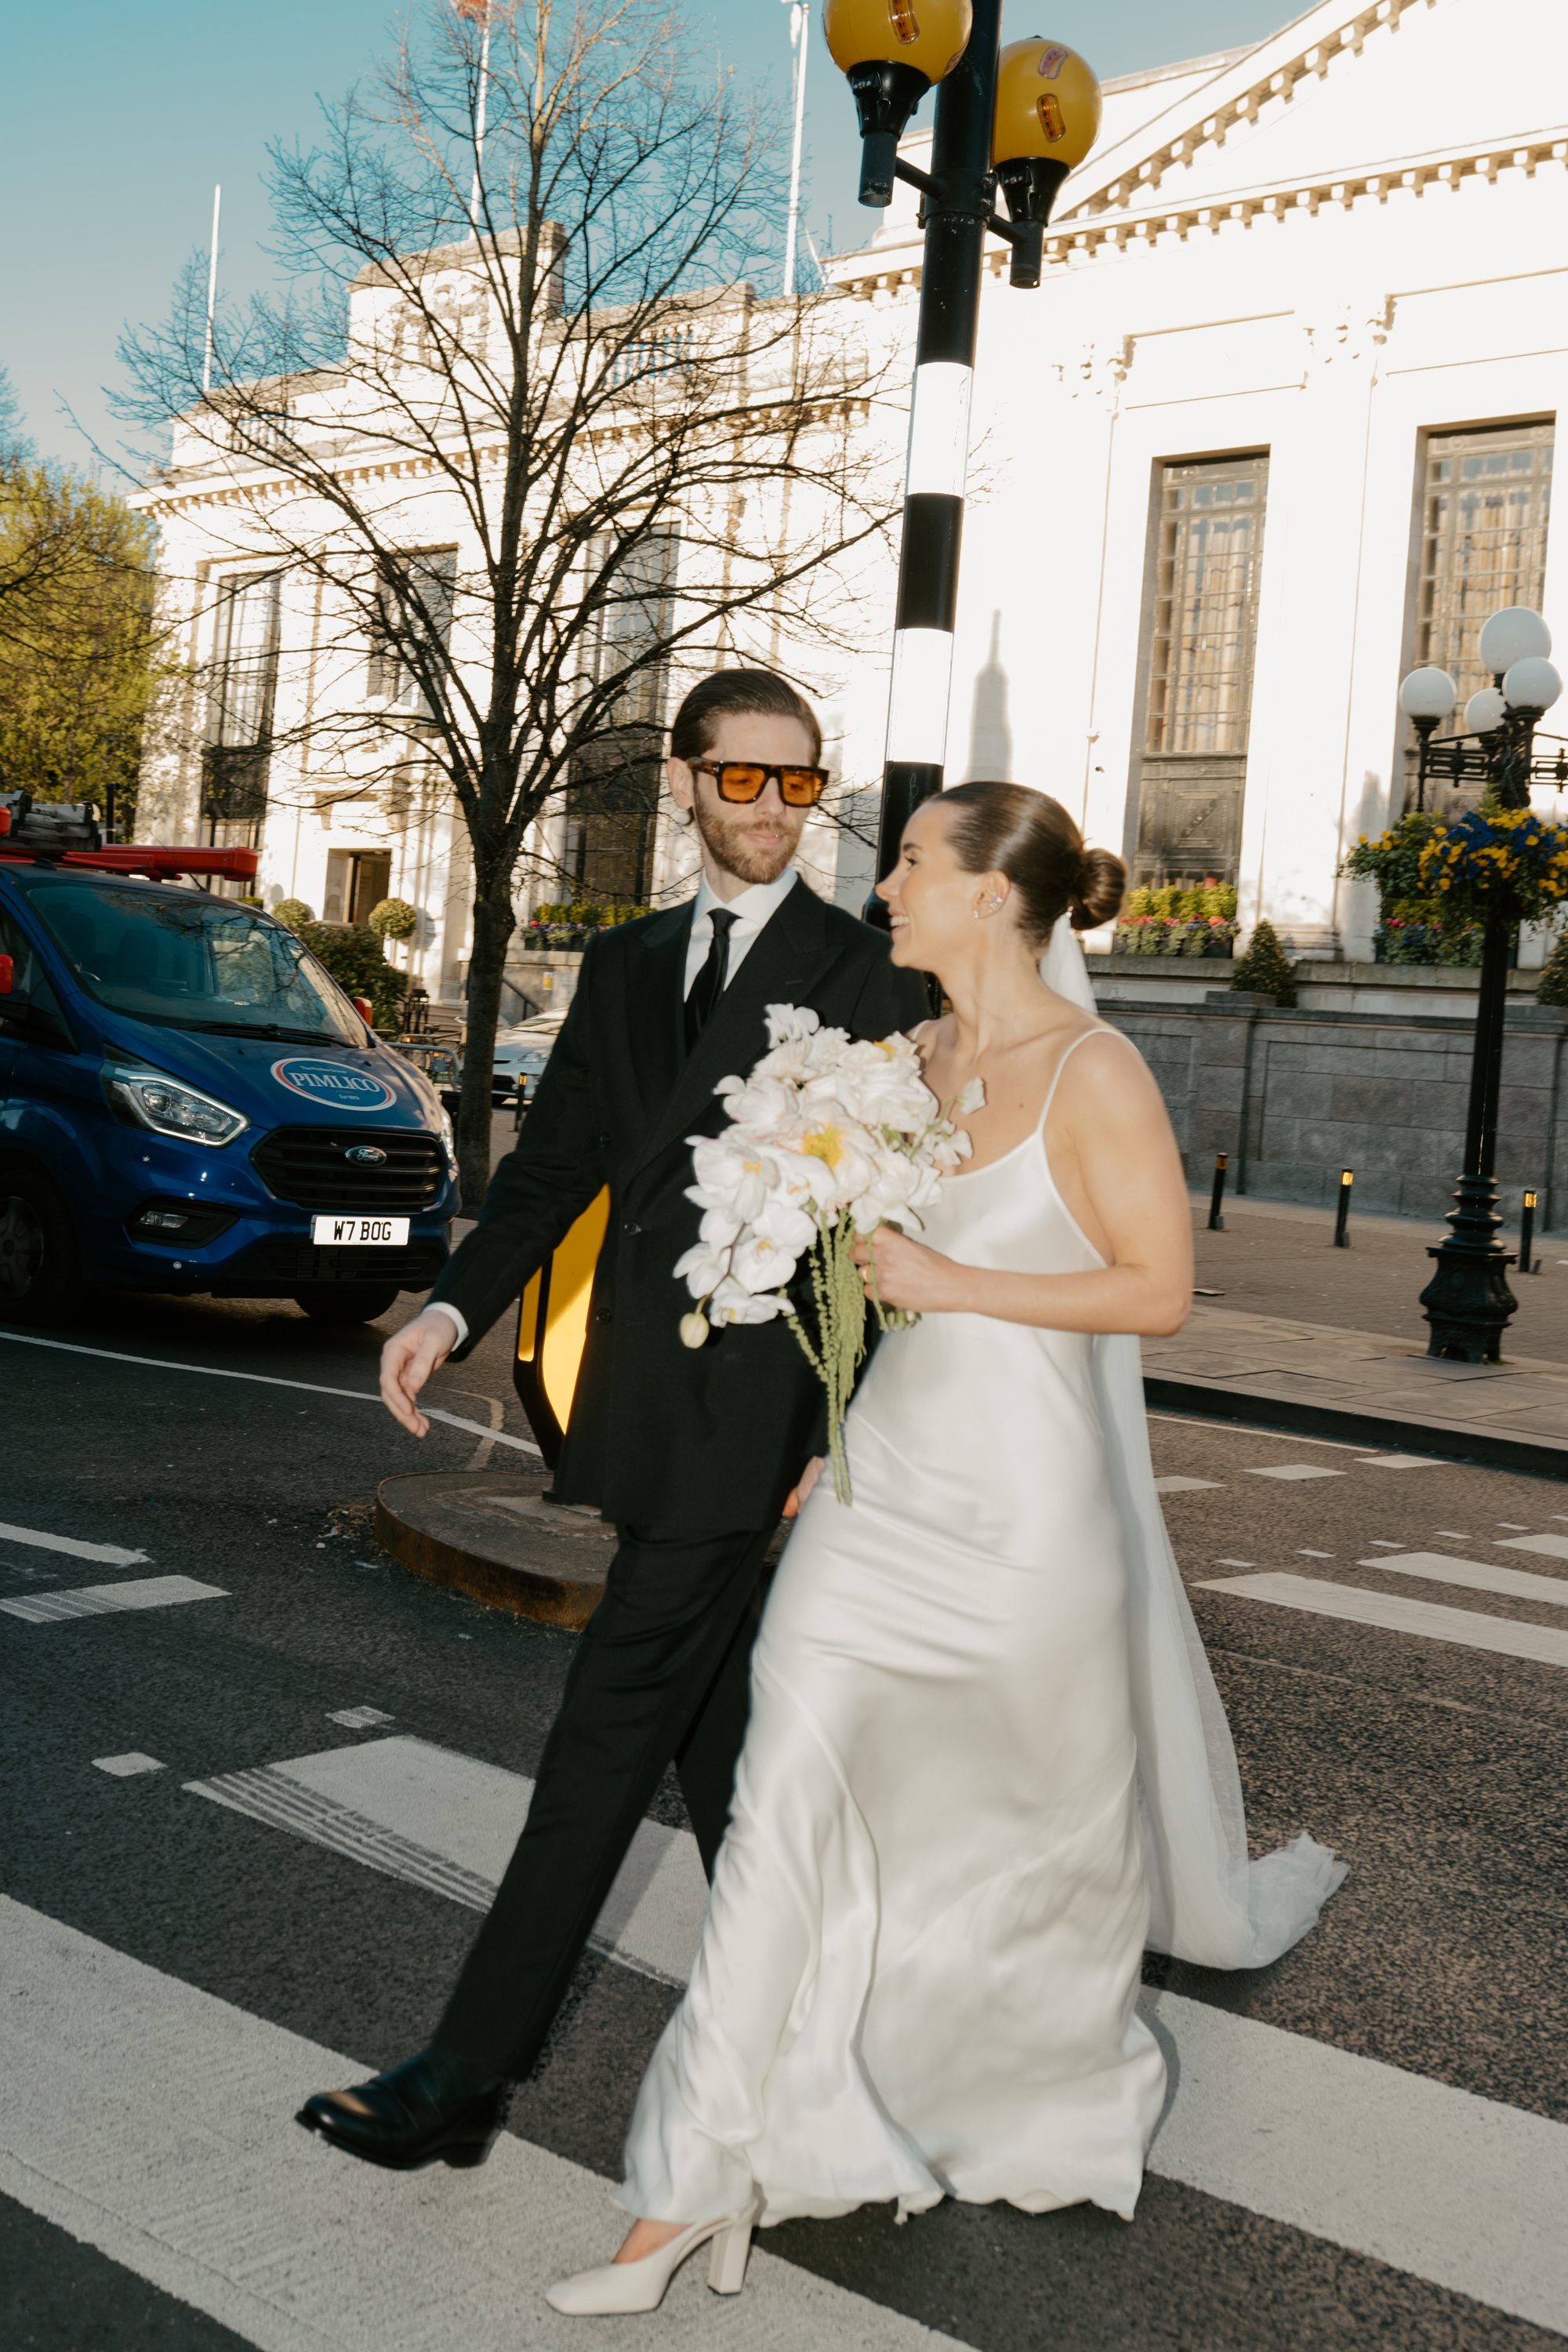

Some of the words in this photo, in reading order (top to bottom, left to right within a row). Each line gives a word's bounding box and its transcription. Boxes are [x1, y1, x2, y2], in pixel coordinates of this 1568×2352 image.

[287, 1073, 380, 1092] PIMLICO
[333, 1221, 355, 1240] W7
[360, 1221, 391, 1240] BOG
